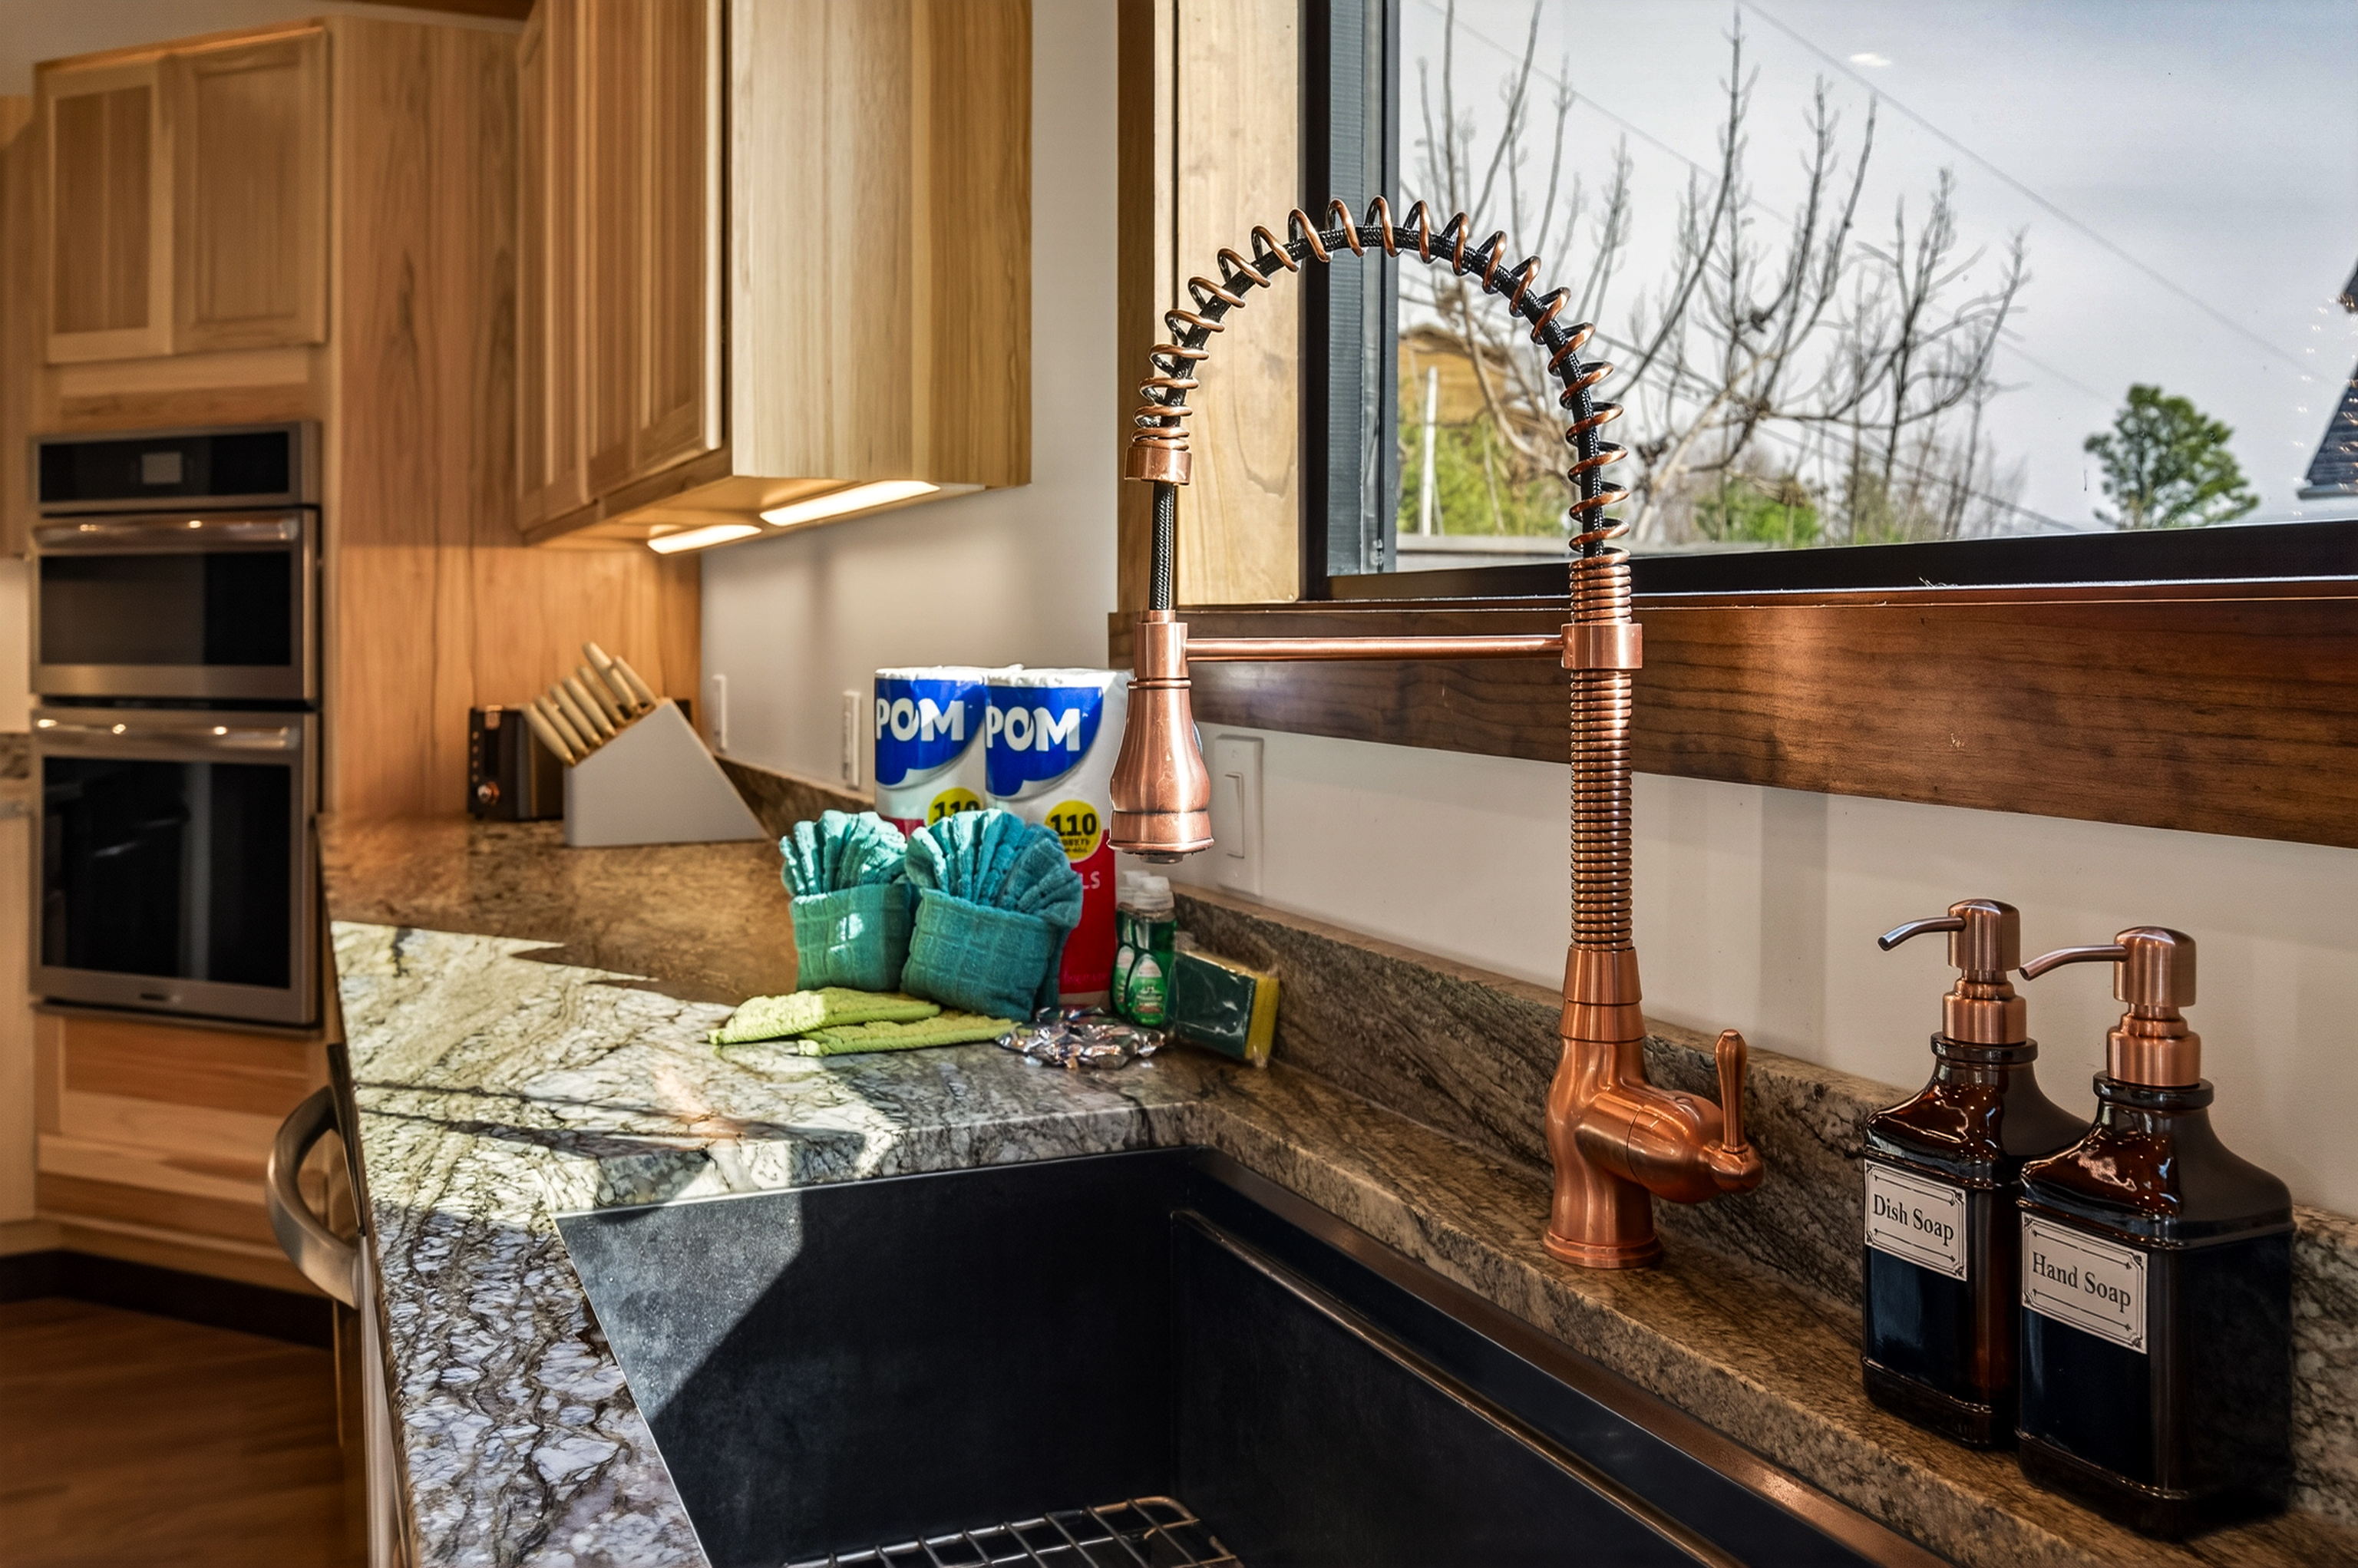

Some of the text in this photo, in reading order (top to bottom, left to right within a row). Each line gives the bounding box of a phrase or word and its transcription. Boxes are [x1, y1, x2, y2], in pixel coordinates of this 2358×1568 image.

[876, 697, 965, 742] POM
[986, 705, 1081, 752] POM
[1050, 813, 1097, 837] 110
[1873, 1193, 1954, 1247] Dish Soap
[2032, 1251, 2132, 1314] Hand Soap
